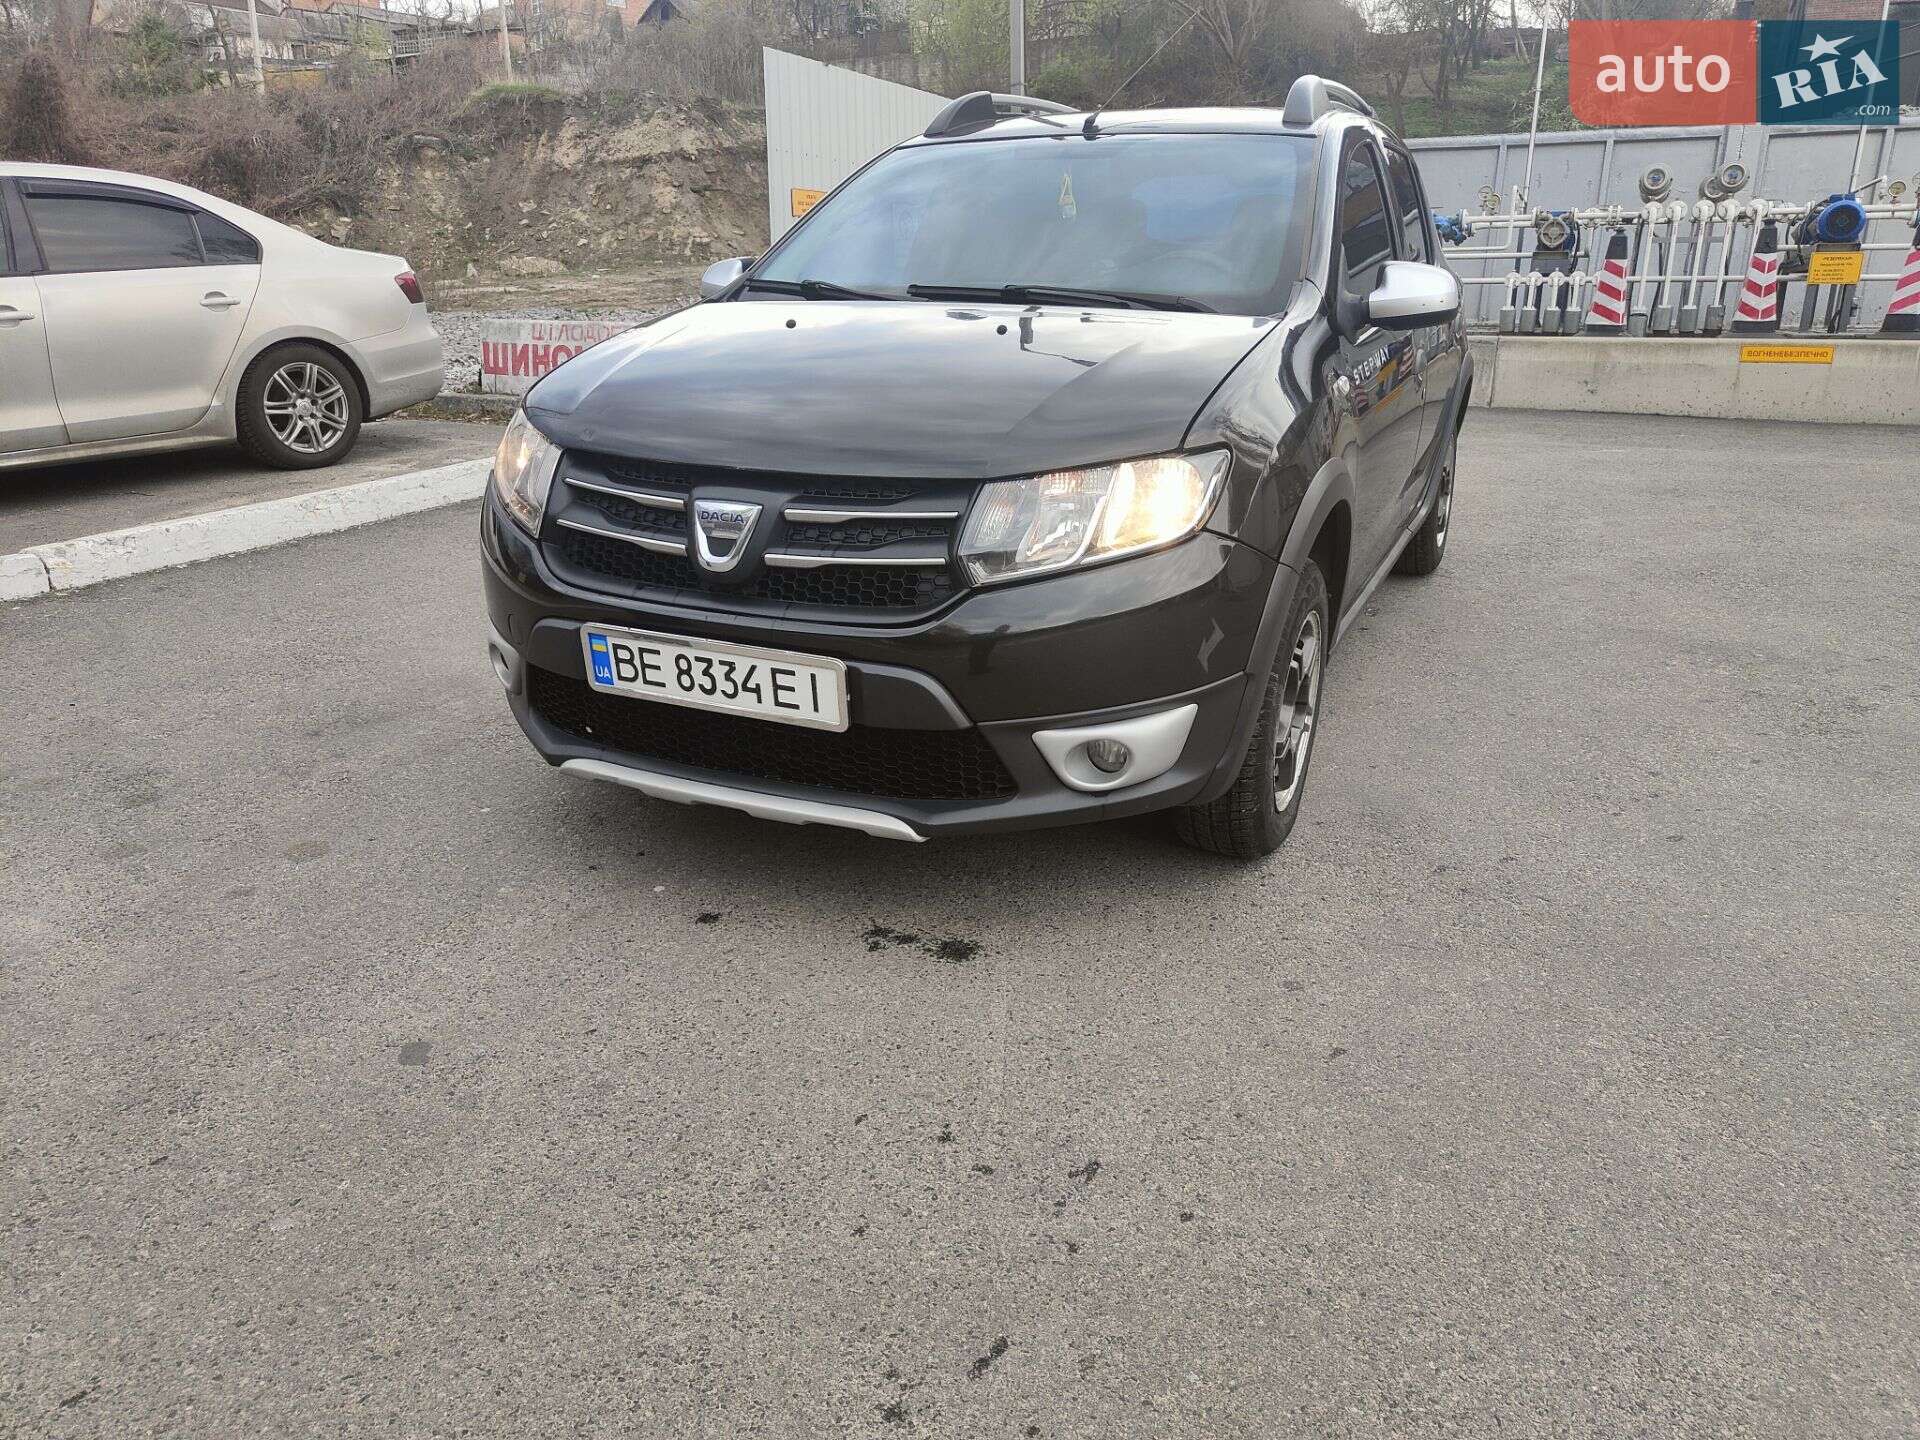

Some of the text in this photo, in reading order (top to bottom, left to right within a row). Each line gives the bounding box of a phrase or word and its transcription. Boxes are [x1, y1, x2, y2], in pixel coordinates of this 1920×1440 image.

[482, 341, 583, 376] ШИНО
[1353, 344, 1391, 386] STEPWAY
[700, 510, 745, 524] DACIA
[595, 665, 611, 678] UA
[612, 642, 819, 713] BE 8334 EI
